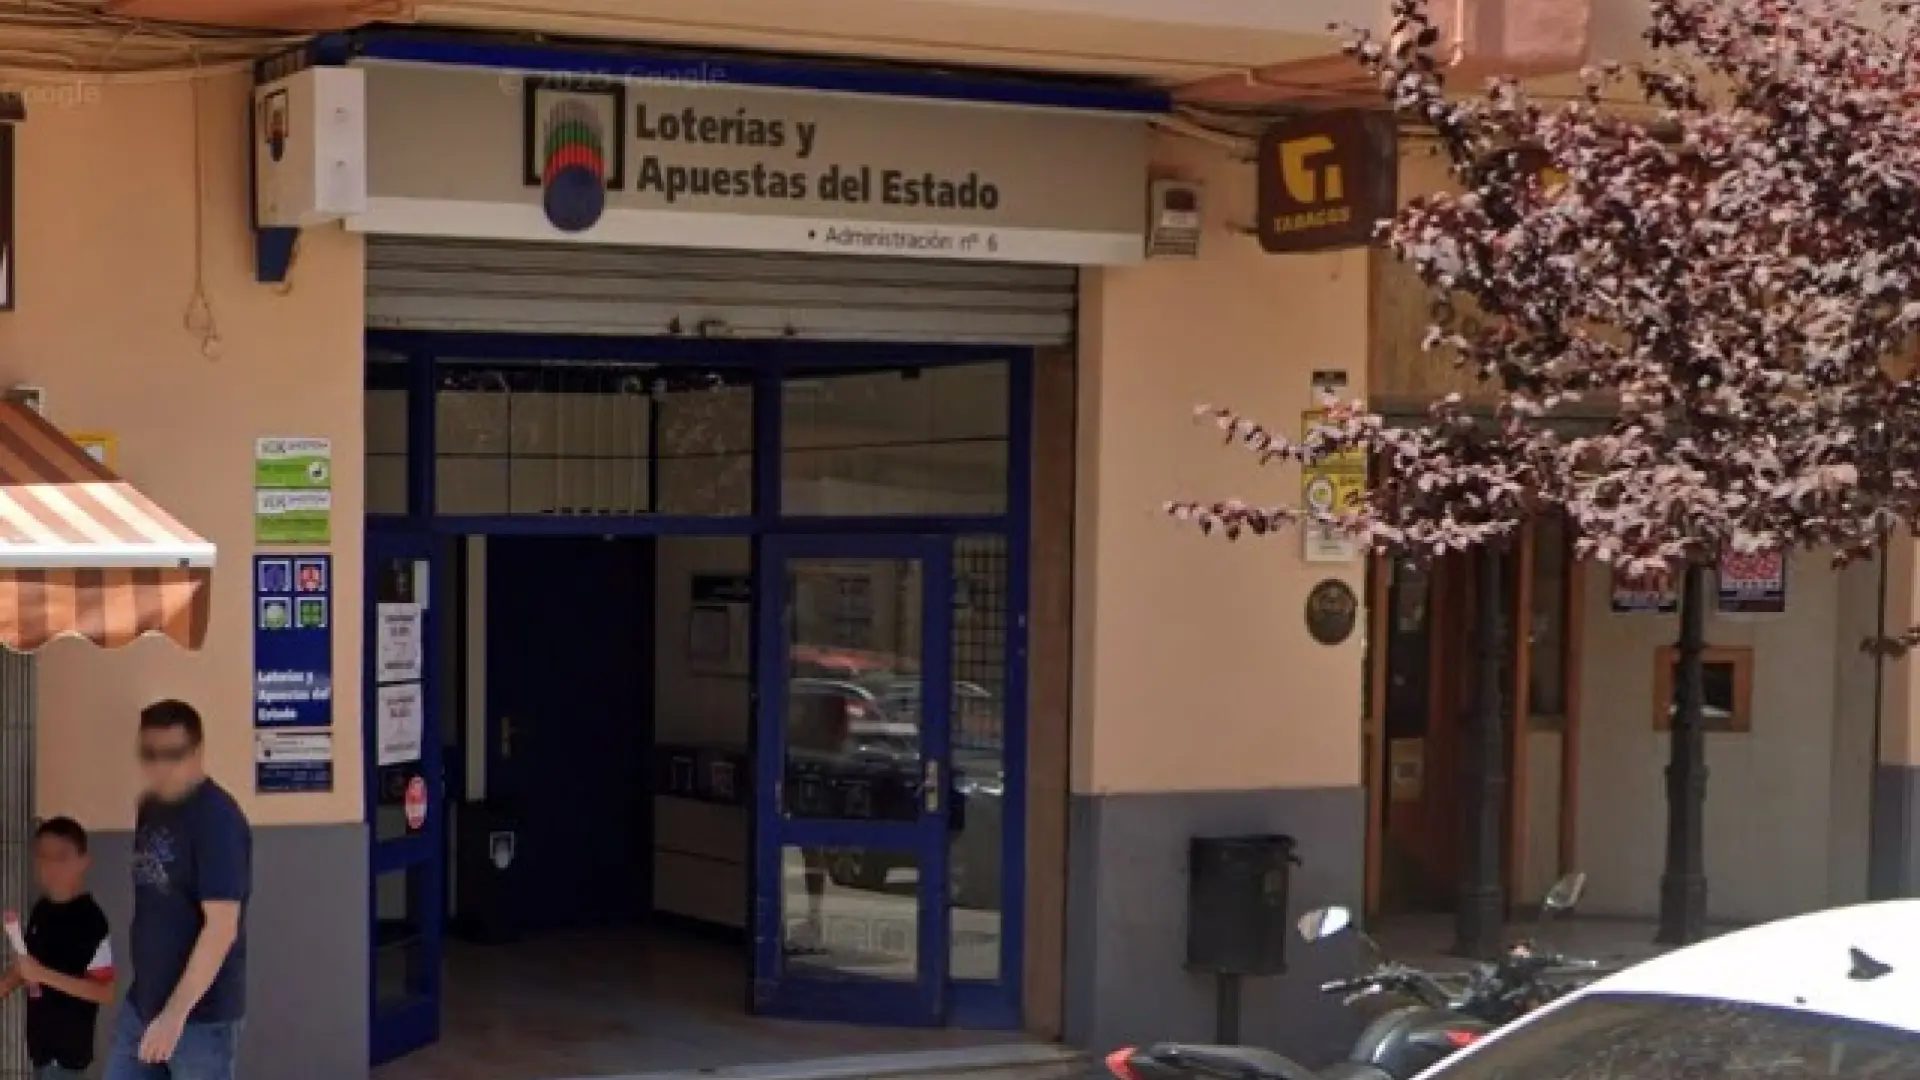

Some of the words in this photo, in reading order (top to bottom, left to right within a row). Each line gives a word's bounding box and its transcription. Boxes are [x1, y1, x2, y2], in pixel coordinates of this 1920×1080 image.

[635, 102, 786, 147] Loterías
[796, 119, 816, 159] y
[637, 155, 807, 203] Apuestas
[818, 164, 871, 202] del
[881, 169, 999, 210] Estado
[825, 227, 952, 250] Administración
[988, 233, 999, 252] 6
